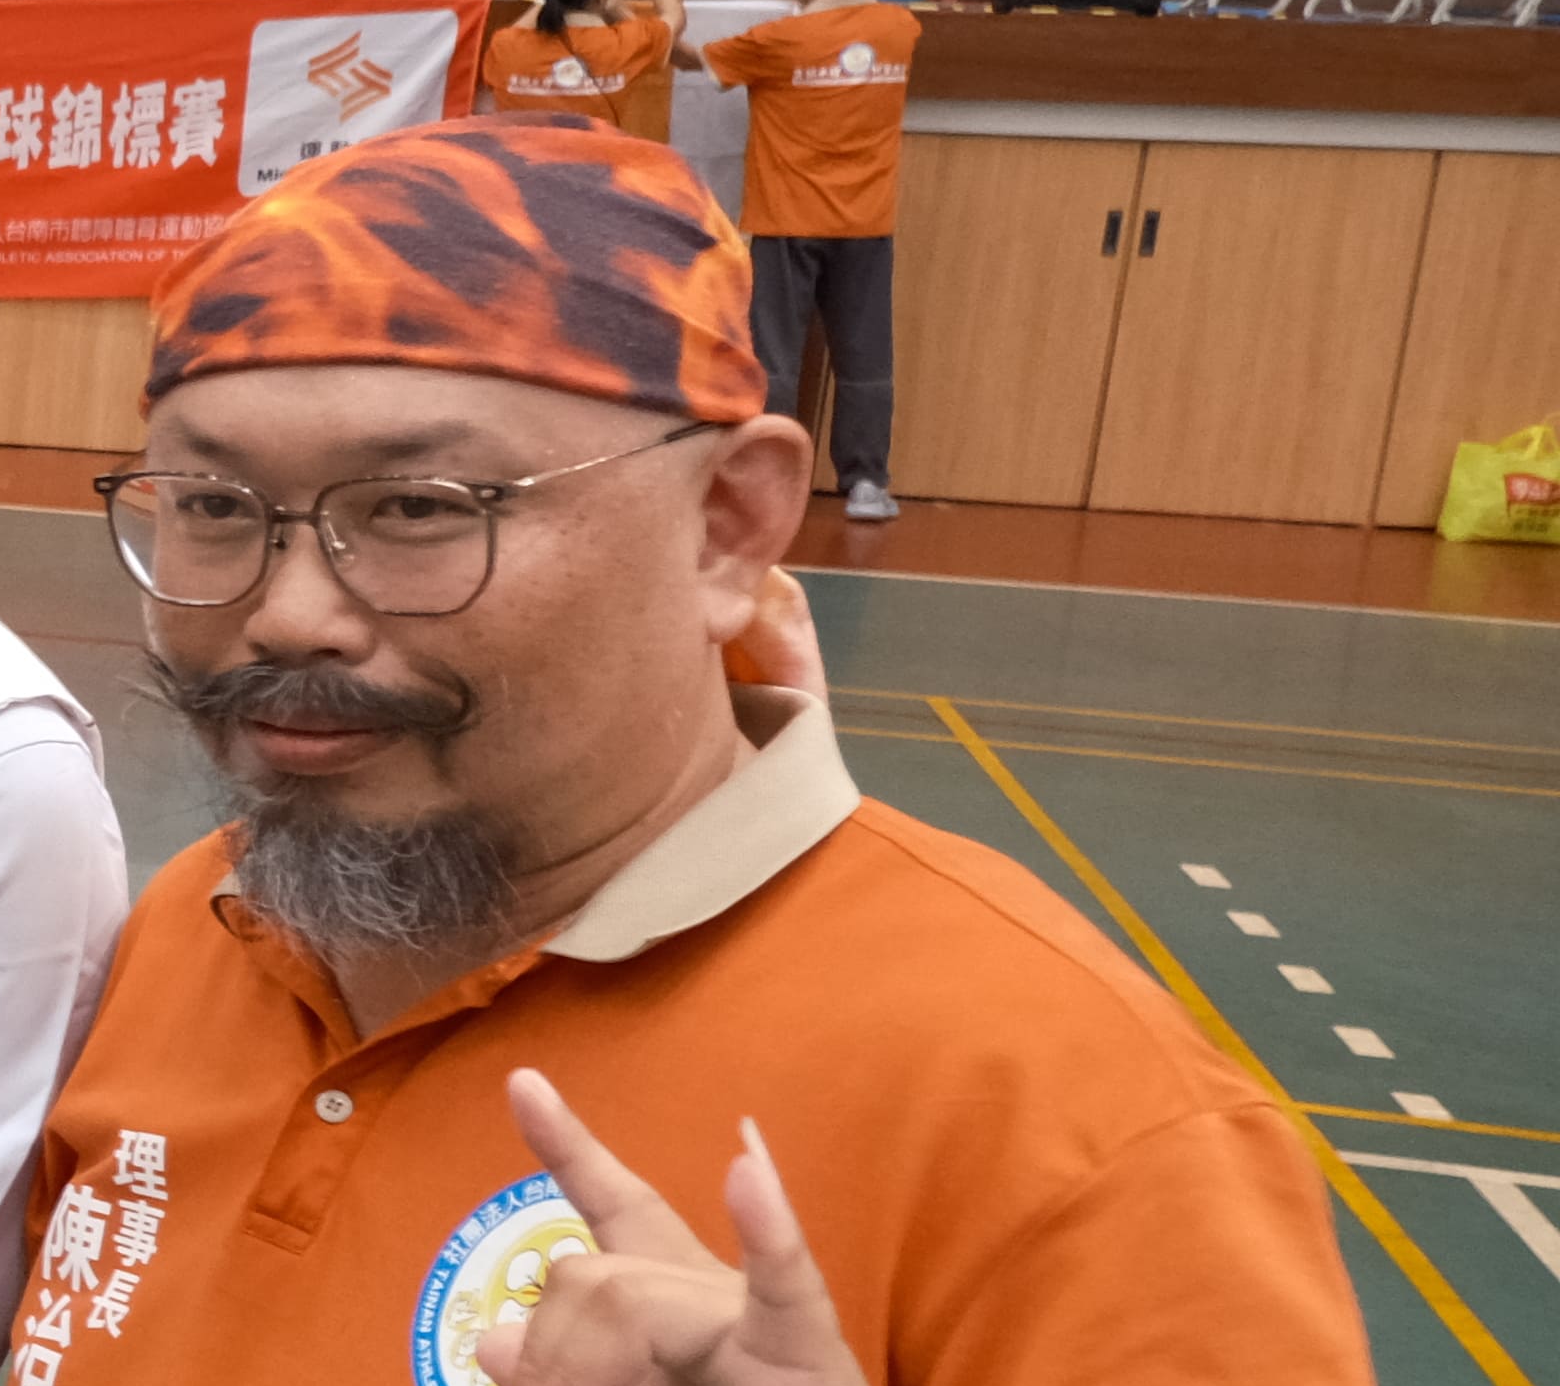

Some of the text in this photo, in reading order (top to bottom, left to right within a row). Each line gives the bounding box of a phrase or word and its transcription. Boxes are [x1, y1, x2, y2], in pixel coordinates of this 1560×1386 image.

[45, 249, 143, 263] ASSOCIATION
[146, 249, 165, 262] OF
[86, 1128, 169, 1339] 理事長
